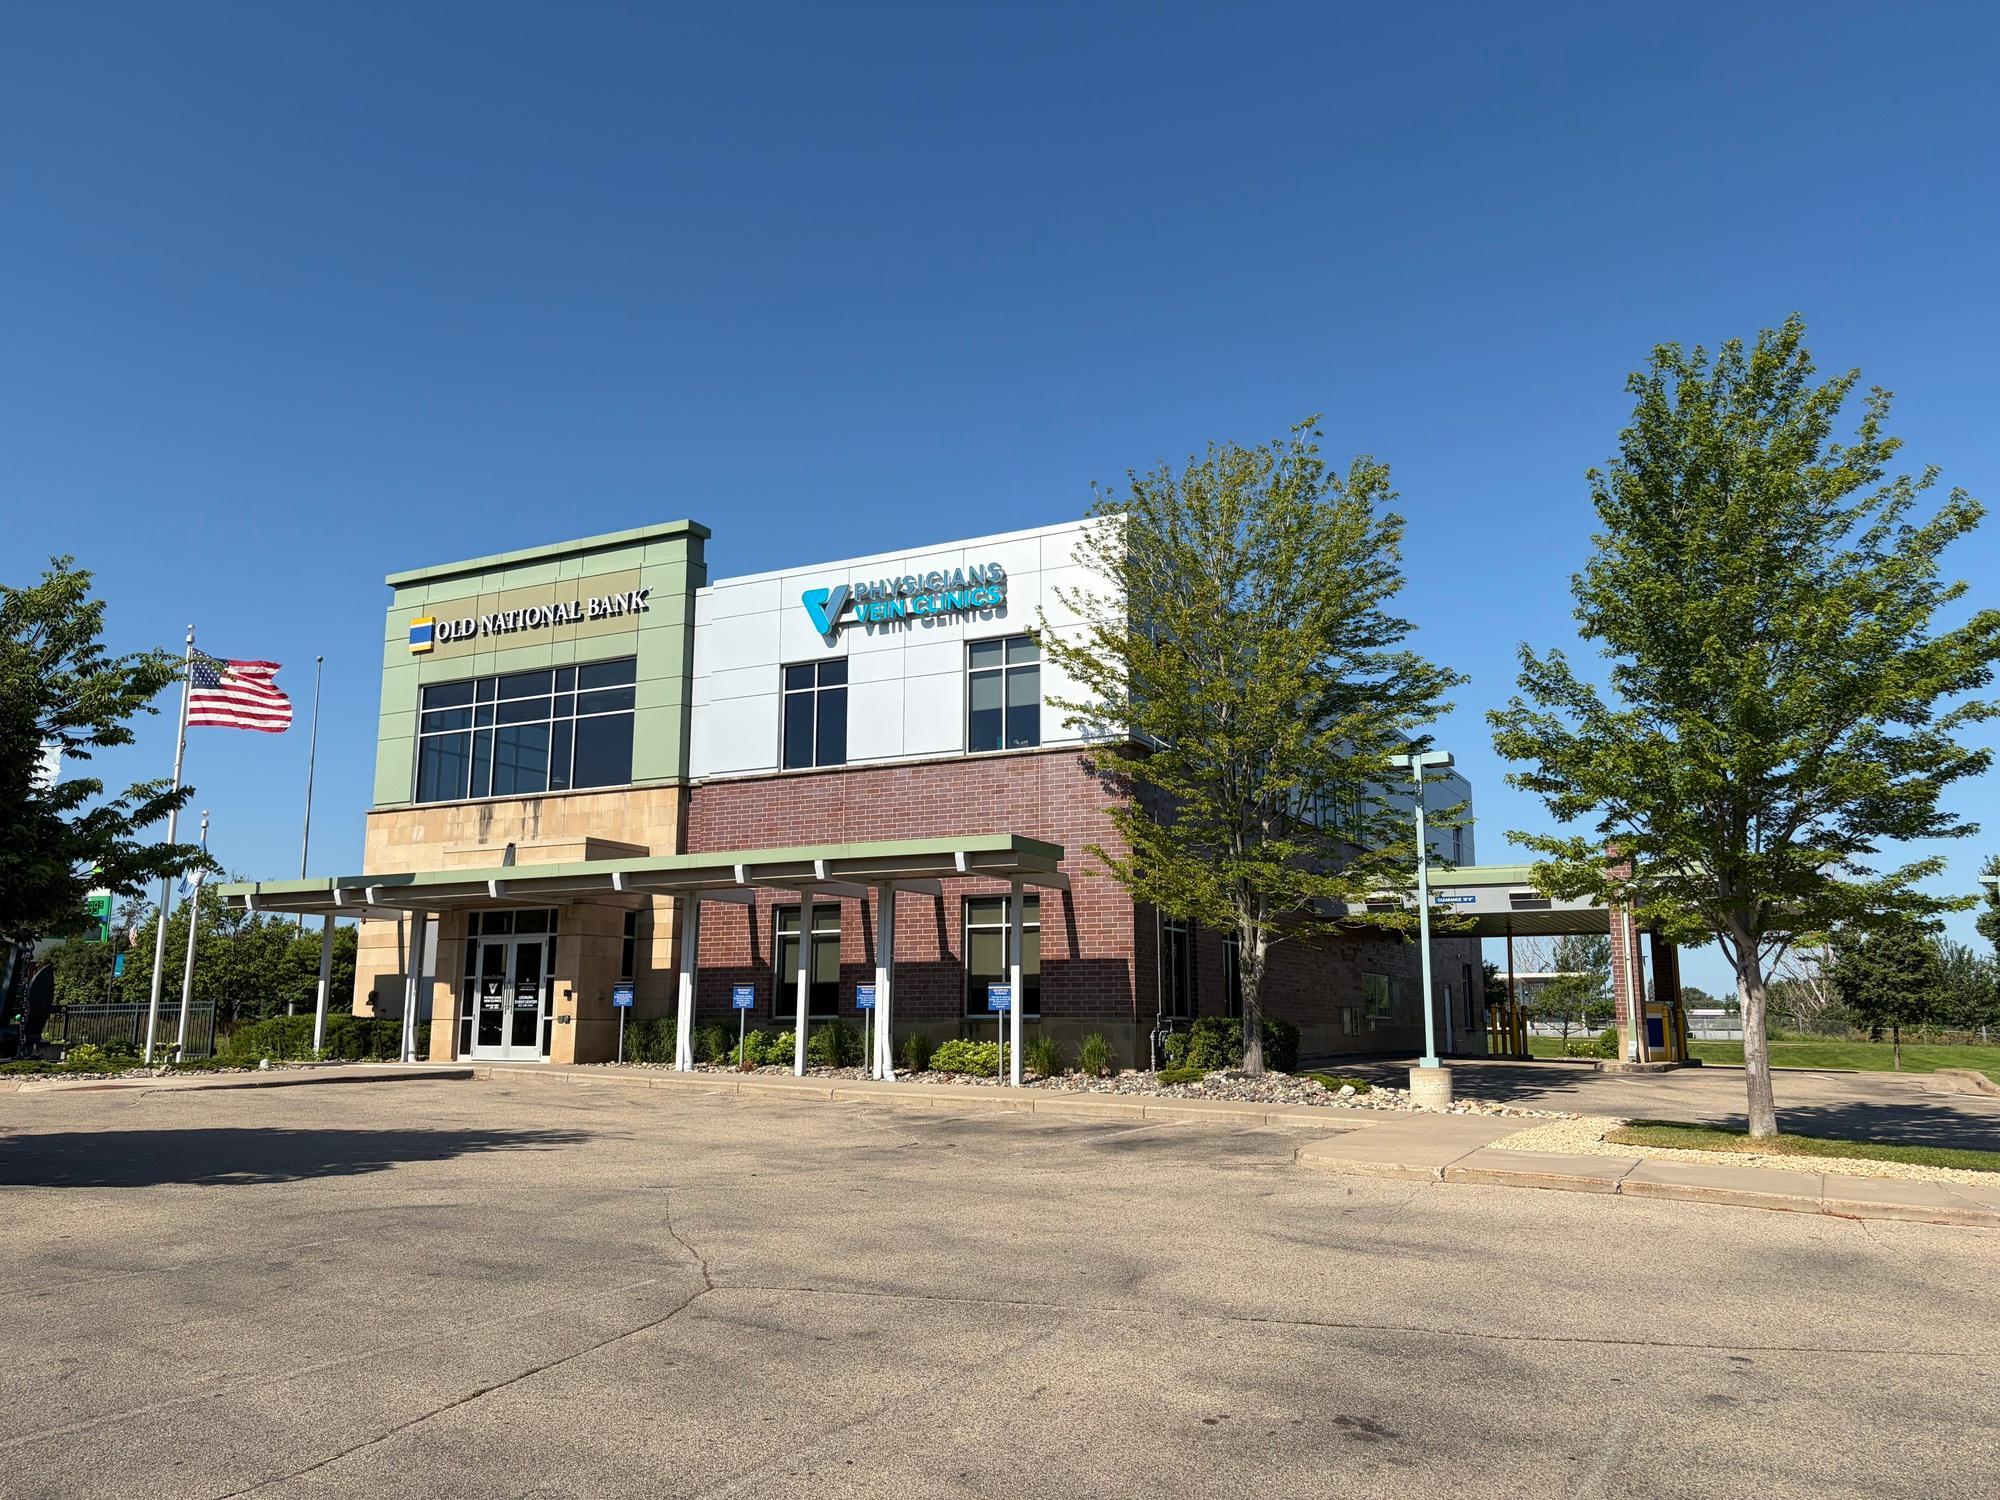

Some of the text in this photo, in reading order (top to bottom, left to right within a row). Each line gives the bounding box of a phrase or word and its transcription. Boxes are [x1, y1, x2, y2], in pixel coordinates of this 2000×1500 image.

[855, 562, 1003, 602] PHYSICIANS
[436, 588, 648, 641] OLD NATIONAL BANK
[854, 585, 1002, 623] VEIN CLINICS
